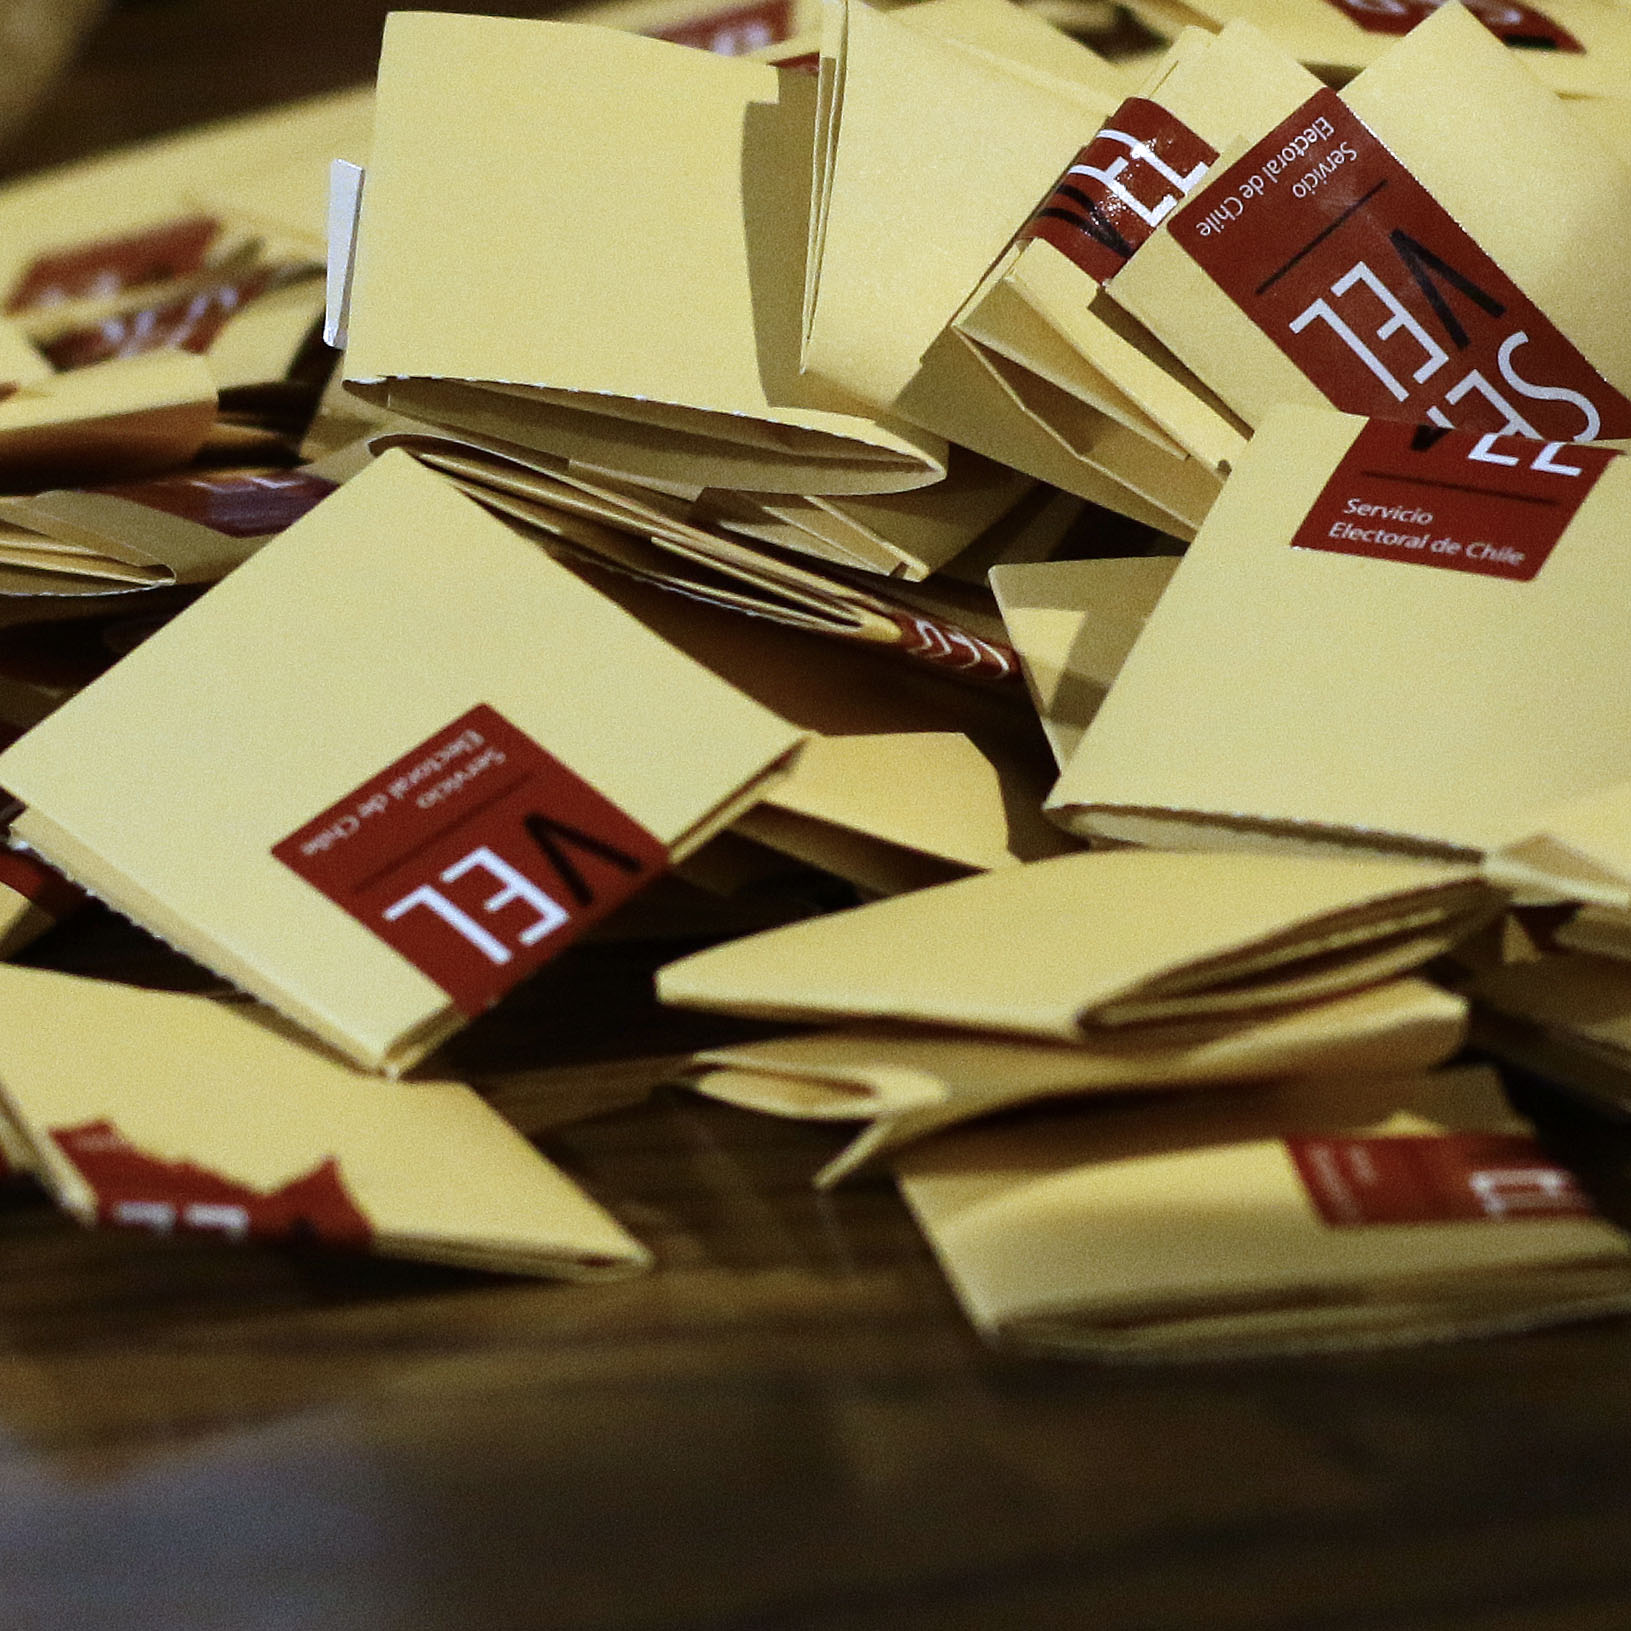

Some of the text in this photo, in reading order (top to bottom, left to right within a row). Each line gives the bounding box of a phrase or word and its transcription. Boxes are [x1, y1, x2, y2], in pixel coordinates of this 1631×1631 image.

[1196, 116, 1335, 237] Electoral de Chile
[1292, 141, 1358, 199] Servicio
[1288, 227, 1509, 403] VEL
[1328, 521, 1526, 566] Electoral de Chile
[1342, 497, 1434, 526] Servicio
[382, 813, 643, 965] VEL
